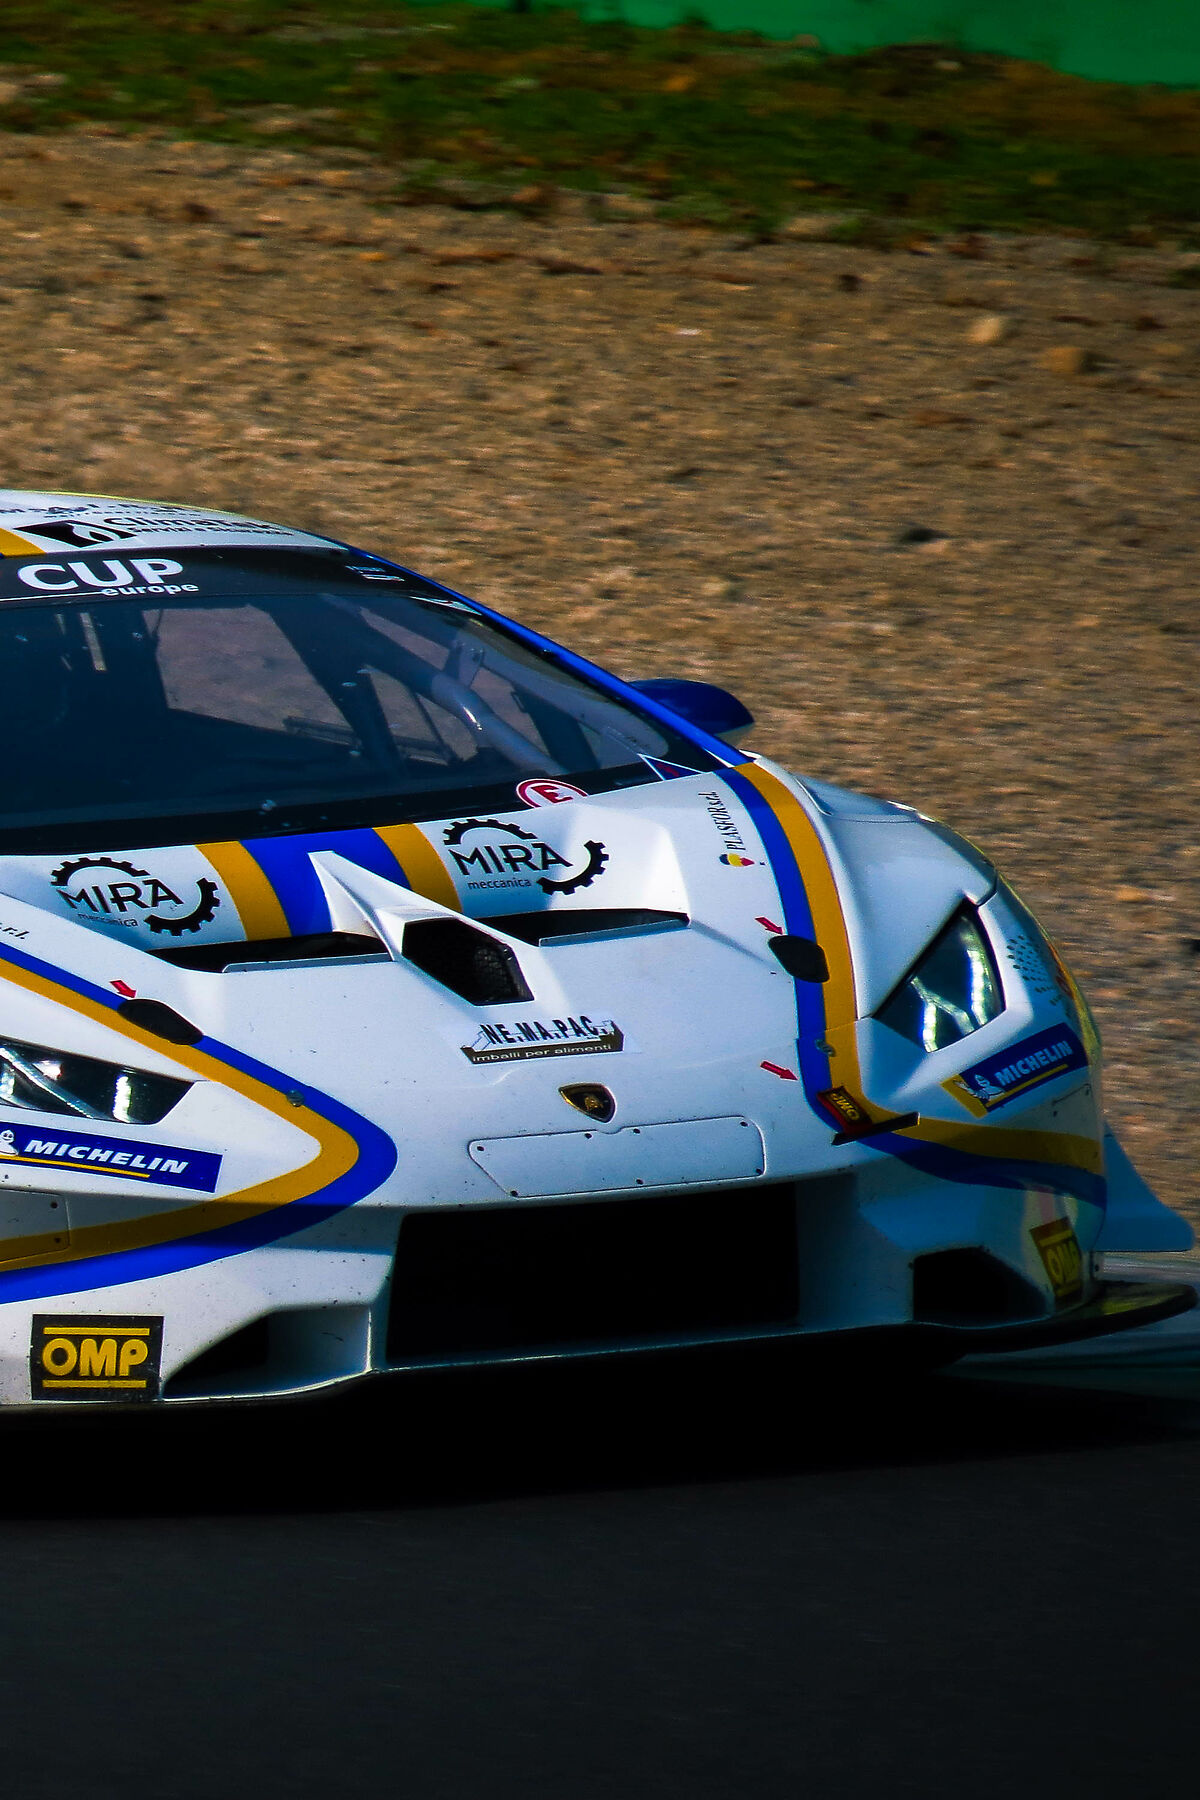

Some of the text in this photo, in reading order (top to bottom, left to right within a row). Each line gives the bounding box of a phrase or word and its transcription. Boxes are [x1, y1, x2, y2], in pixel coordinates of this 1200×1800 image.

[17, 558, 185, 591] CUP
[101, 582, 200, 598] europe
[448, 842, 574, 876] MIRA
[56, 878, 184, 914] MIRA
[467, 876, 532, 890] meccanica
[472, 1043, 613, 1063] imballi per alimenti
[993, 1040, 1074, 1087] MICHELIN
[23, 1139, 189, 1174] MICHELIN
[42, 1337, 149, 1377] OMP
